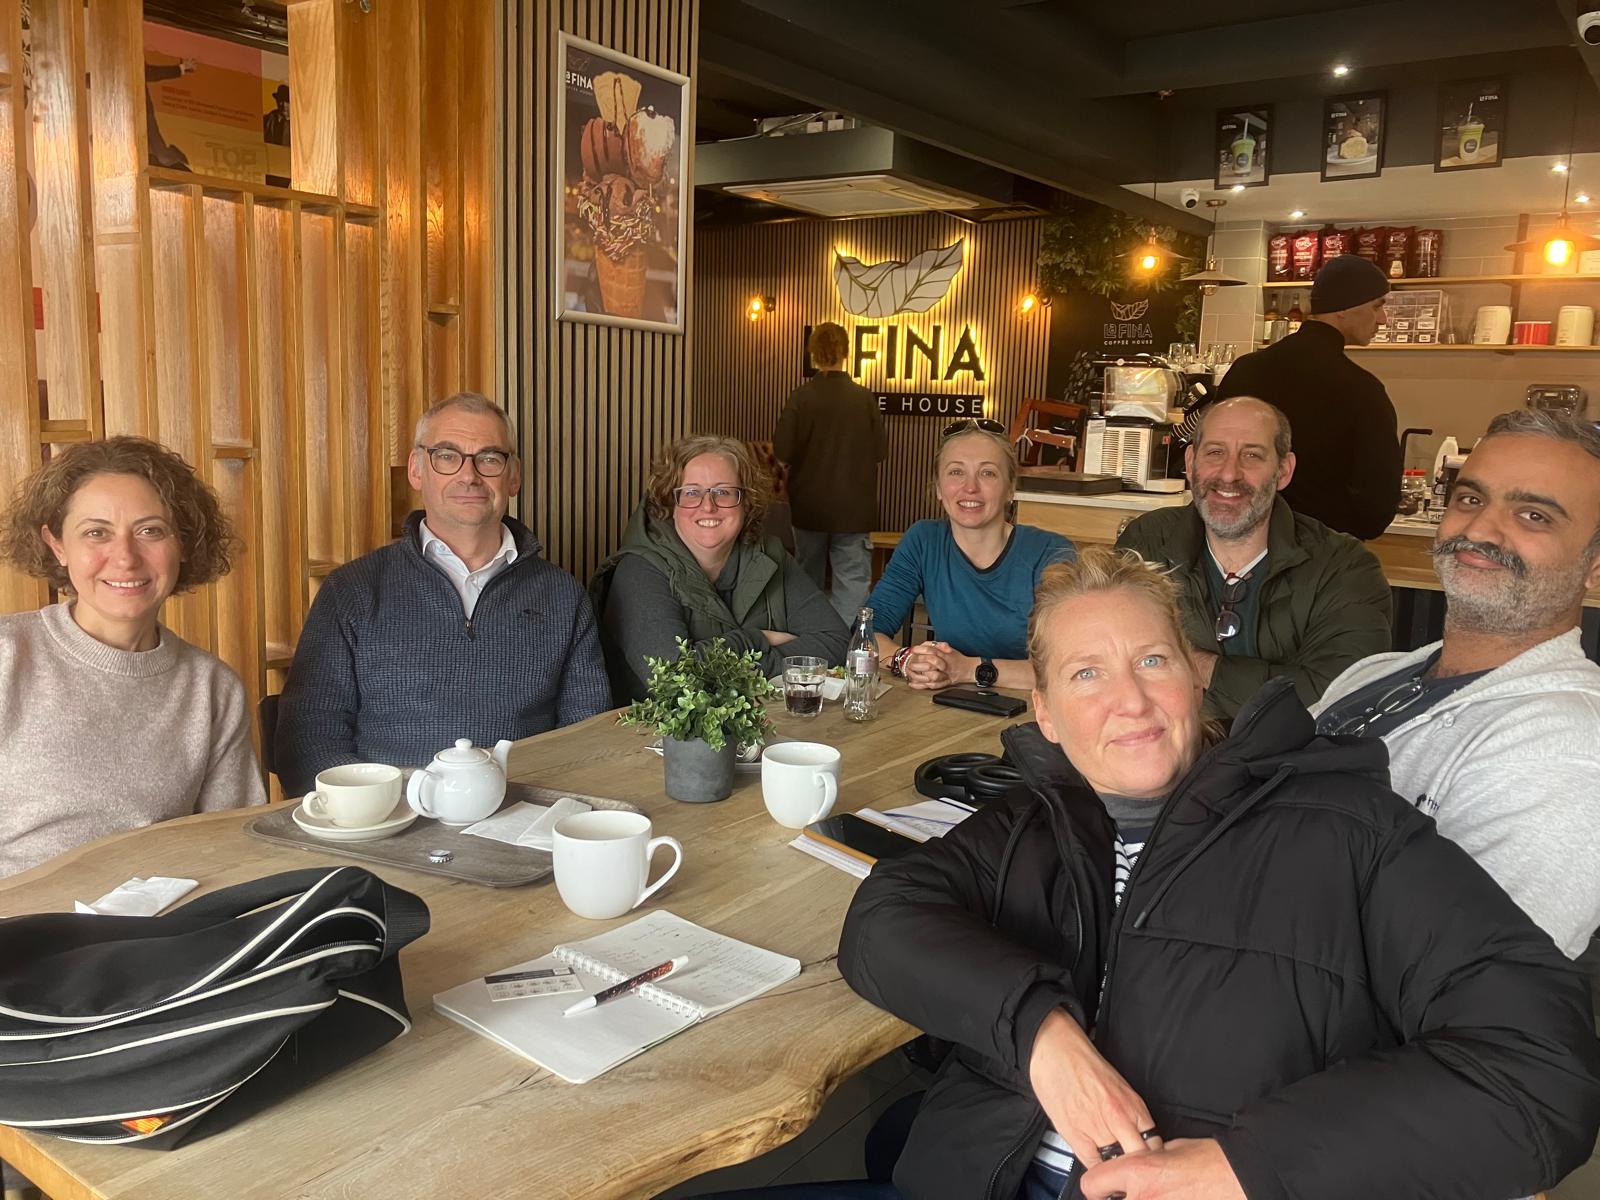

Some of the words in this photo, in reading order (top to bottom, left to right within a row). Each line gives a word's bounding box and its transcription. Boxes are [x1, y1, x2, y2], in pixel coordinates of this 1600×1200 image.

[571, 72, 593, 90] FINA
[1118, 323, 1153, 339] FINA
[853, 323, 985, 381] FINA
[901, 397, 981, 414] HOUSE
